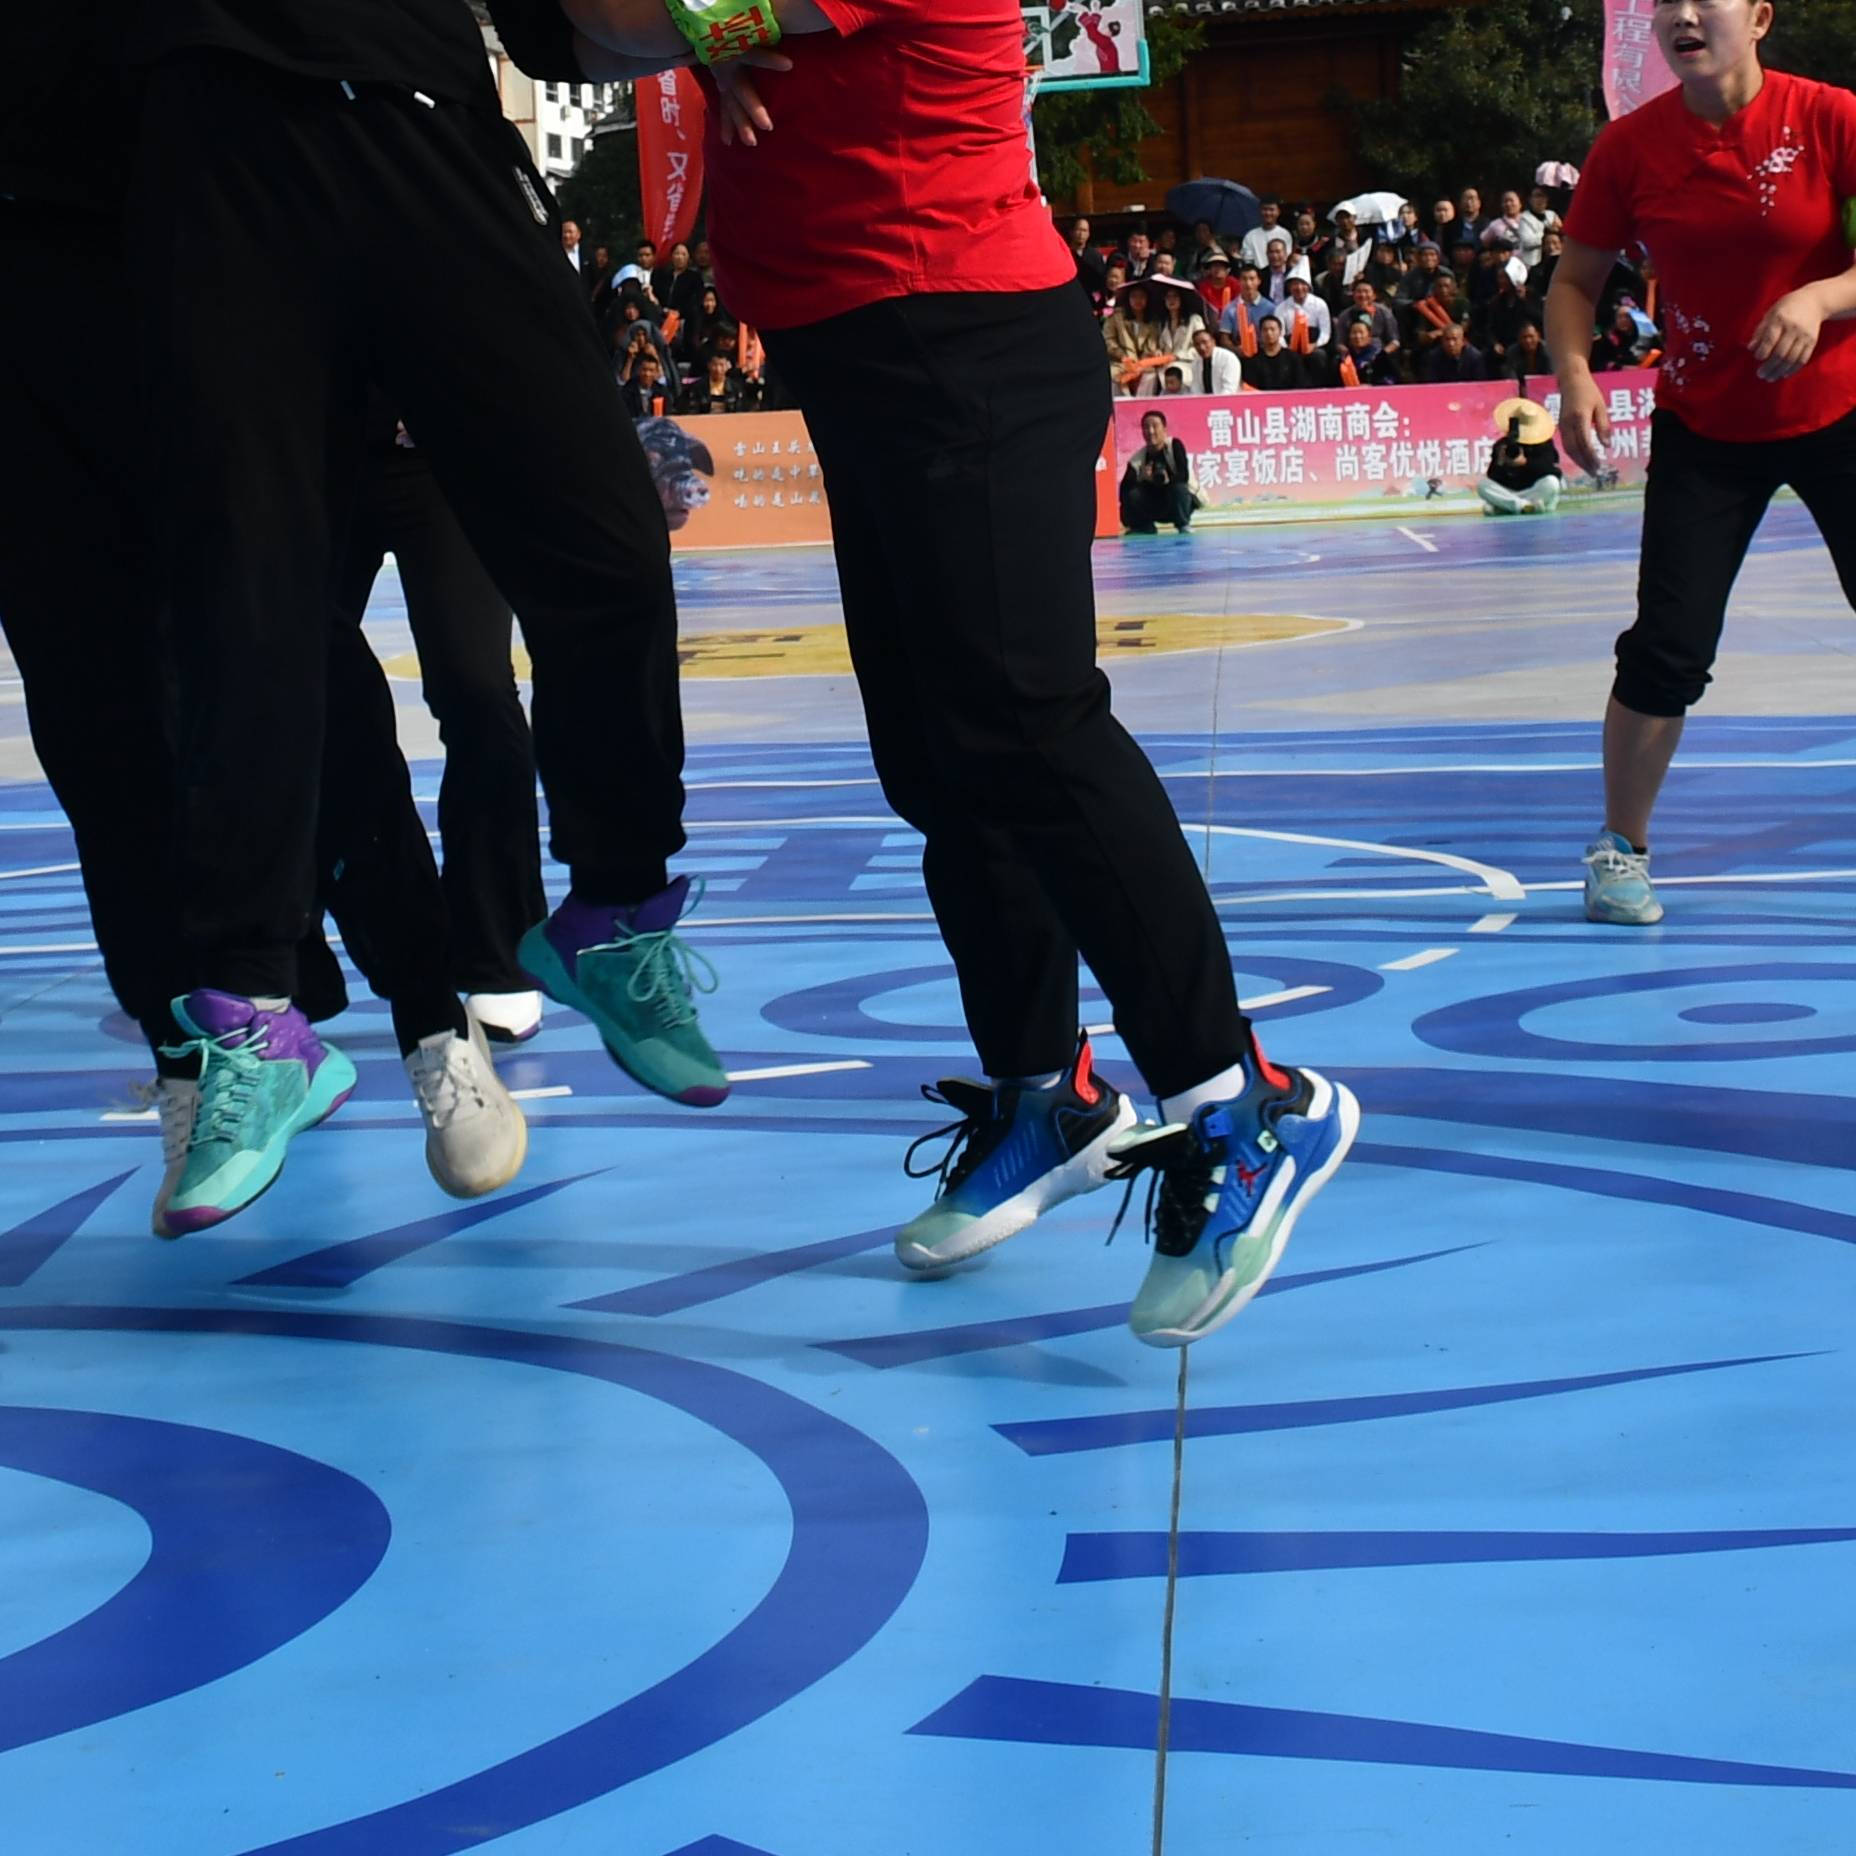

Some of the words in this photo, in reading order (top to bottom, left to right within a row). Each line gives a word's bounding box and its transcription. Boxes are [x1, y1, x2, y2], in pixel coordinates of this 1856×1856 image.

[1186, 436, 1495, 489] 家宴饭店、尚客优悦酒店
